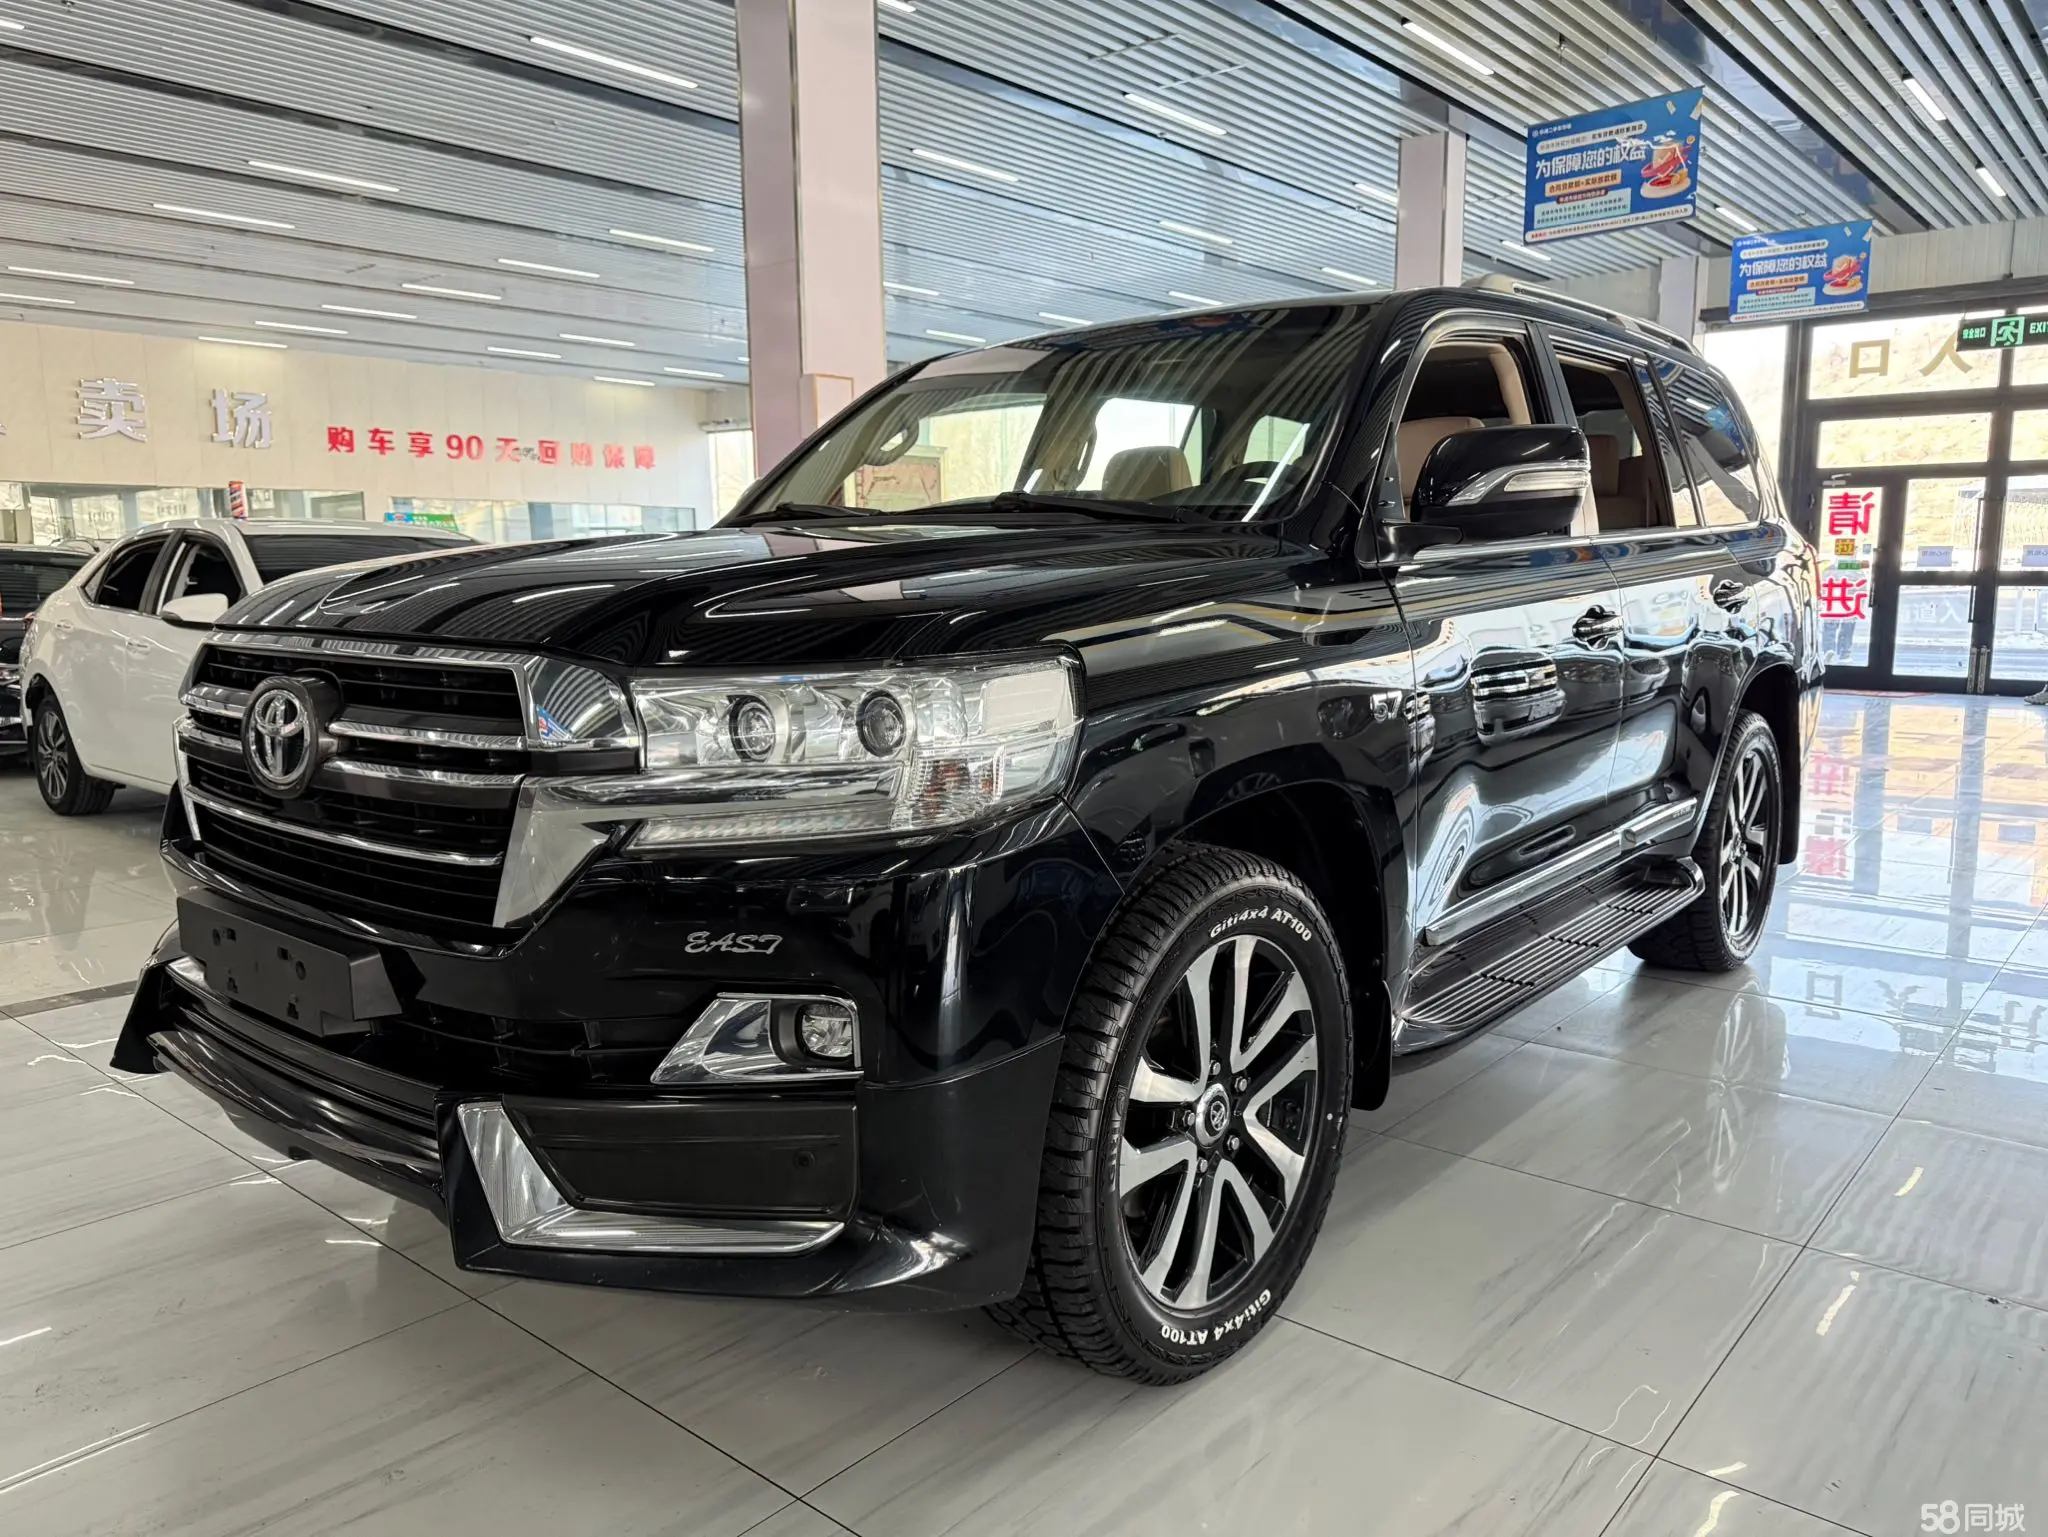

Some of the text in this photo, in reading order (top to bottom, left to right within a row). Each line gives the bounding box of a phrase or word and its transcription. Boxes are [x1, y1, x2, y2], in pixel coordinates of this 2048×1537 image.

[1535, 141, 1646, 179] 为保障您的权益
[1739, 253, 1828, 277] 为保障您的权益
[1209, 905, 1312, 941] Giti4x4 AT100
[685, 931, 783, 954] EAST
[1161, 1288, 1271, 1345] Giti4x4 AT100
